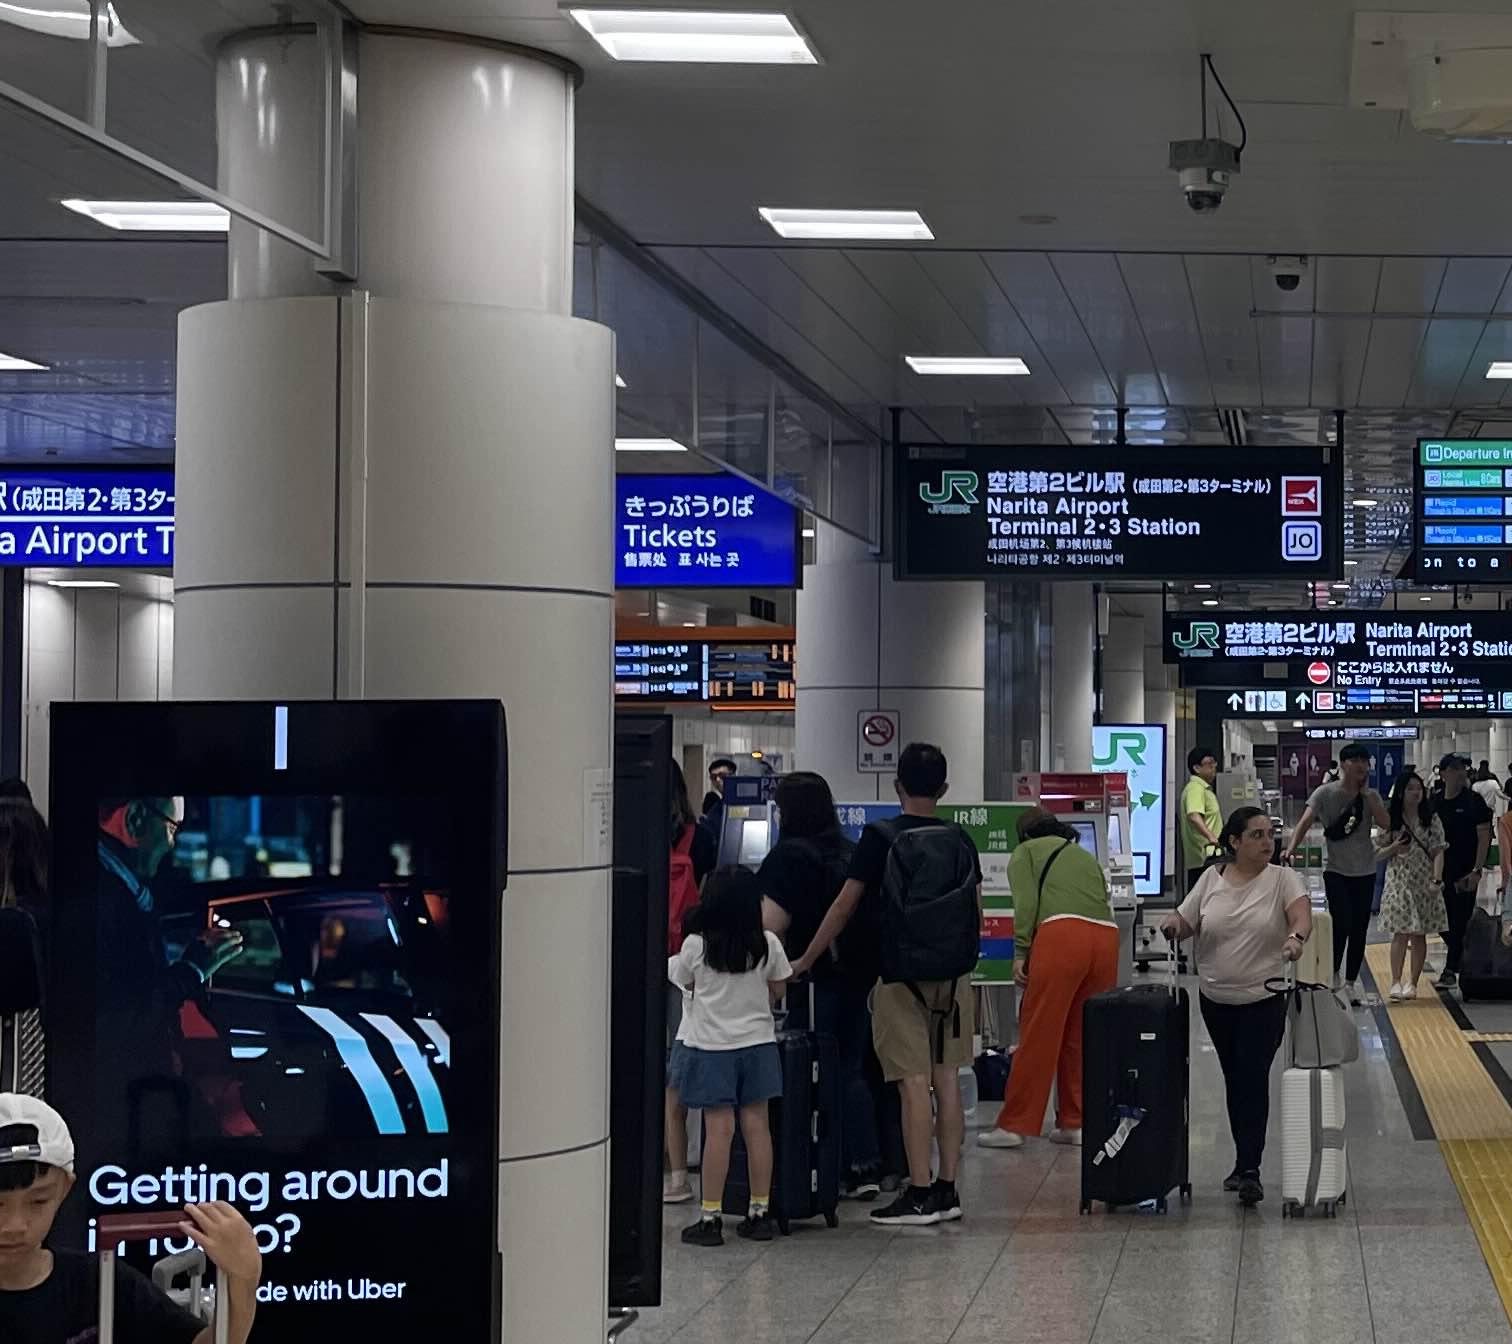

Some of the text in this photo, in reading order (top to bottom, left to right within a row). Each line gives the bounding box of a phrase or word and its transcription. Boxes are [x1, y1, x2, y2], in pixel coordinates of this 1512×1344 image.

[1443, 447, 1500, 461] Departure
[920, 471, 980, 504] JR
[987, 471, 1125, 494] 空港第2ビル駅
[625, 495, 754, 518] きっぷうりば
[987, 497, 1048, 514] Narita
[1056, 497, 1129, 518] Airport
[624, 523, 717, 548] Tickets
[987, 518, 1077, 535] Terminal
[1127, 518, 1200, 535] Station
[25, 525, 148, 563] Airport
[1290, 533, 1313, 548] JO
[696, 552, 722, 567] 사는
[1457, 557, 1477, 567] to
[1490, 558, 1499, 567] a
[1172, 622, 1221, 649] JR
[1225, 623, 1355, 644] 空港第2ビル駅
[1366, 622, 1472, 641] Narita Airport
[1366, 641, 1435, 656] Terminal
[1337, 662, 1453, 674] ここからは入れません
[1337, 675, 1352, 685] No
[1355, 675, 1381, 687] Entry
[1093, 733, 1146, 765] JR
[89, 1158, 448, 1211] Getting around
[293, 1279, 342, 1302] with
[347, 1278, 406, 1300] Uber
